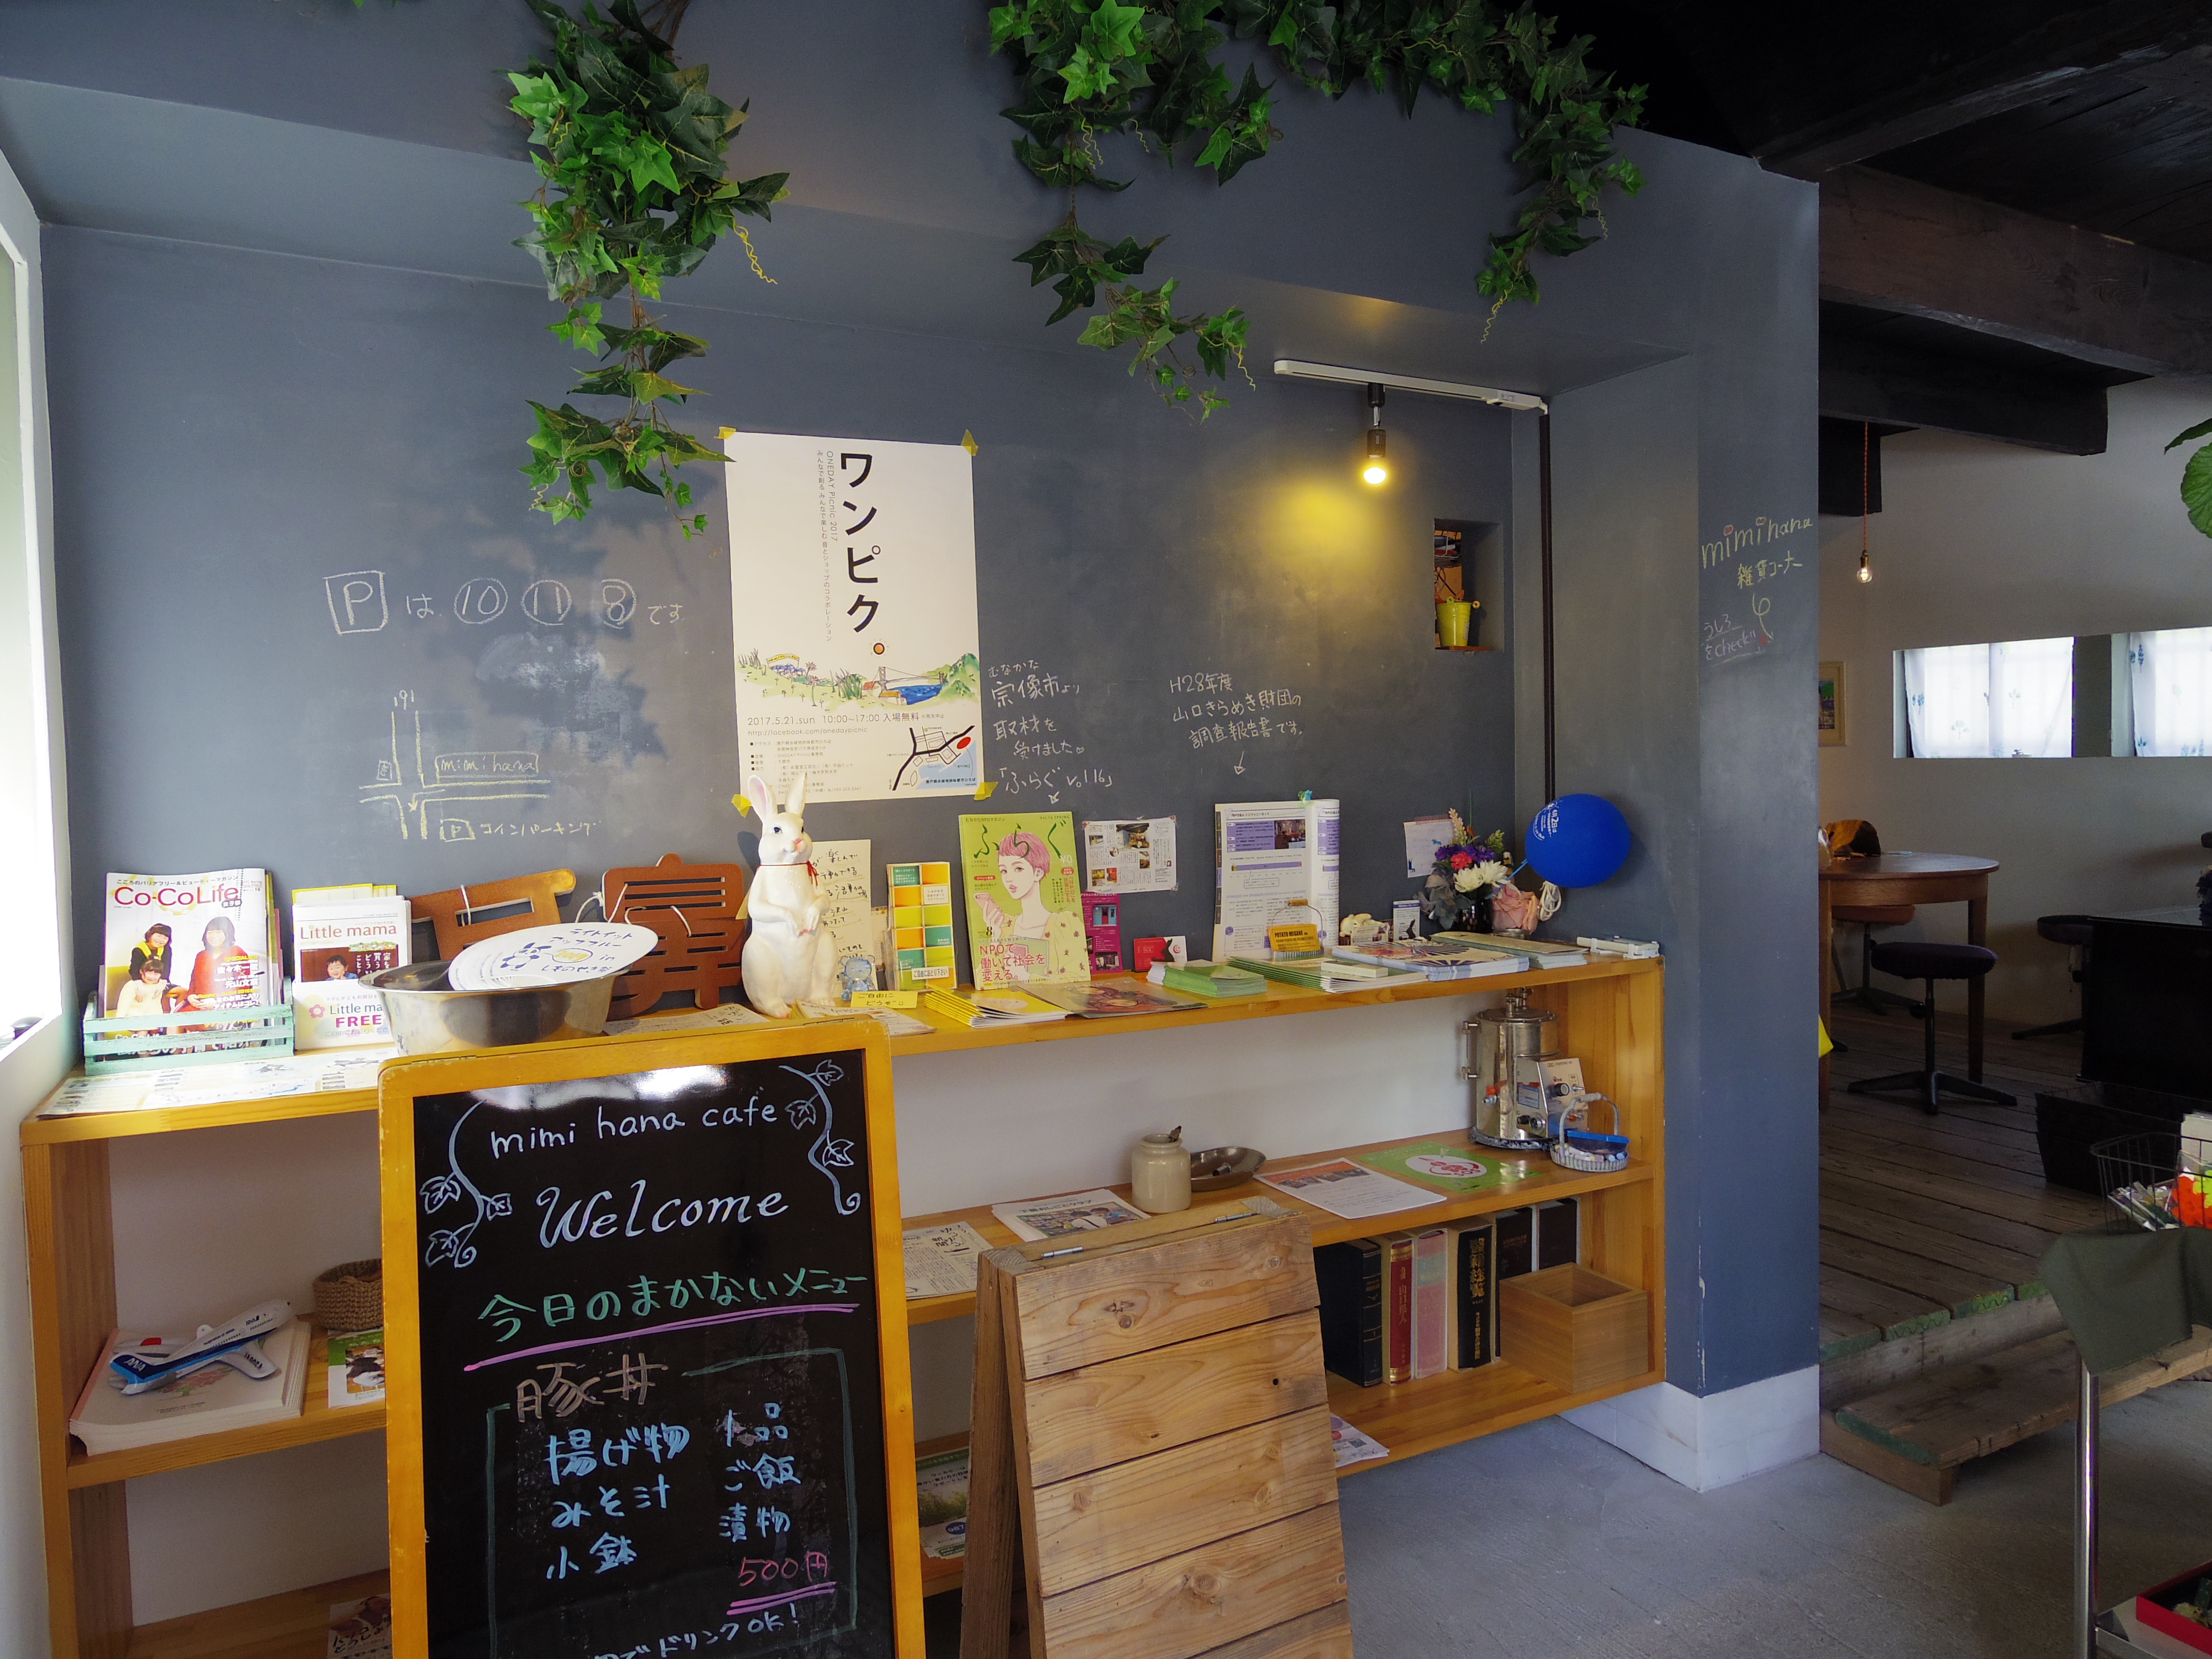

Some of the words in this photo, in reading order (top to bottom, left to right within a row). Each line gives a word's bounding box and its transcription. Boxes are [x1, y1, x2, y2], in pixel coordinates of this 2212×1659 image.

[827, 451, 835, 488] ONEDAY
[828, 491, 837, 518] Picnic
[830, 522, 838, 541] 2017
[1738, 550, 1803, 589] 雑貨コーナー
[342, 580, 373, 625] P
[647, 603, 684, 625] です
[988, 660, 1039, 678] むなかた
[992, 675, 1080, 707] 宗像市より
[1170, 672, 1233, 695] H28年度
[1173, 688, 1301, 722] 山口きらめき財団の
[748, 717, 816, 726] 2017.5.21.sun
[883, 712, 920, 722] 入場無料
[993, 716, 1057, 741] 取材を
[748, 727, 868, 737] http://facebook.com/onedaypicnic
[974, 820, 1066, 859] ふらぐ
[300, 925, 342, 940] Little
[347, 925, 397, 937] mama
[980, 943, 1014, 955] NPOで
[981, 953, 1045, 969] 働いて社会を
[914, 969, 948, 978] ご自由におとり下さい
[983, 969, 1019, 983] 変える。
[330, 1003, 361, 1015] Little
[364, 1004, 383, 1013] ma
[335, 1014, 383, 1028] FREE
[325, 1027, 389, 1037] ご自由にお取りくださ
[490, 1123, 576, 1159] mimi
[597, 1106, 685, 1139] hana
[536, 1180, 789, 1249] Welcome
[478, 1267, 868, 1342] 今日のまかないメニュー
[124, 1357, 146, 1372] ANA
[546, 1422, 690, 1485] 揚げ物
[551, 1473, 671, 1528] みそ汁
[725, 1455, 801, 1491] ご飯
[546, 1531, 638, 1579] 小鉢
[719, 1503, 791, 1542] 漬物
[738, 1550, 828, 1586] 500円
